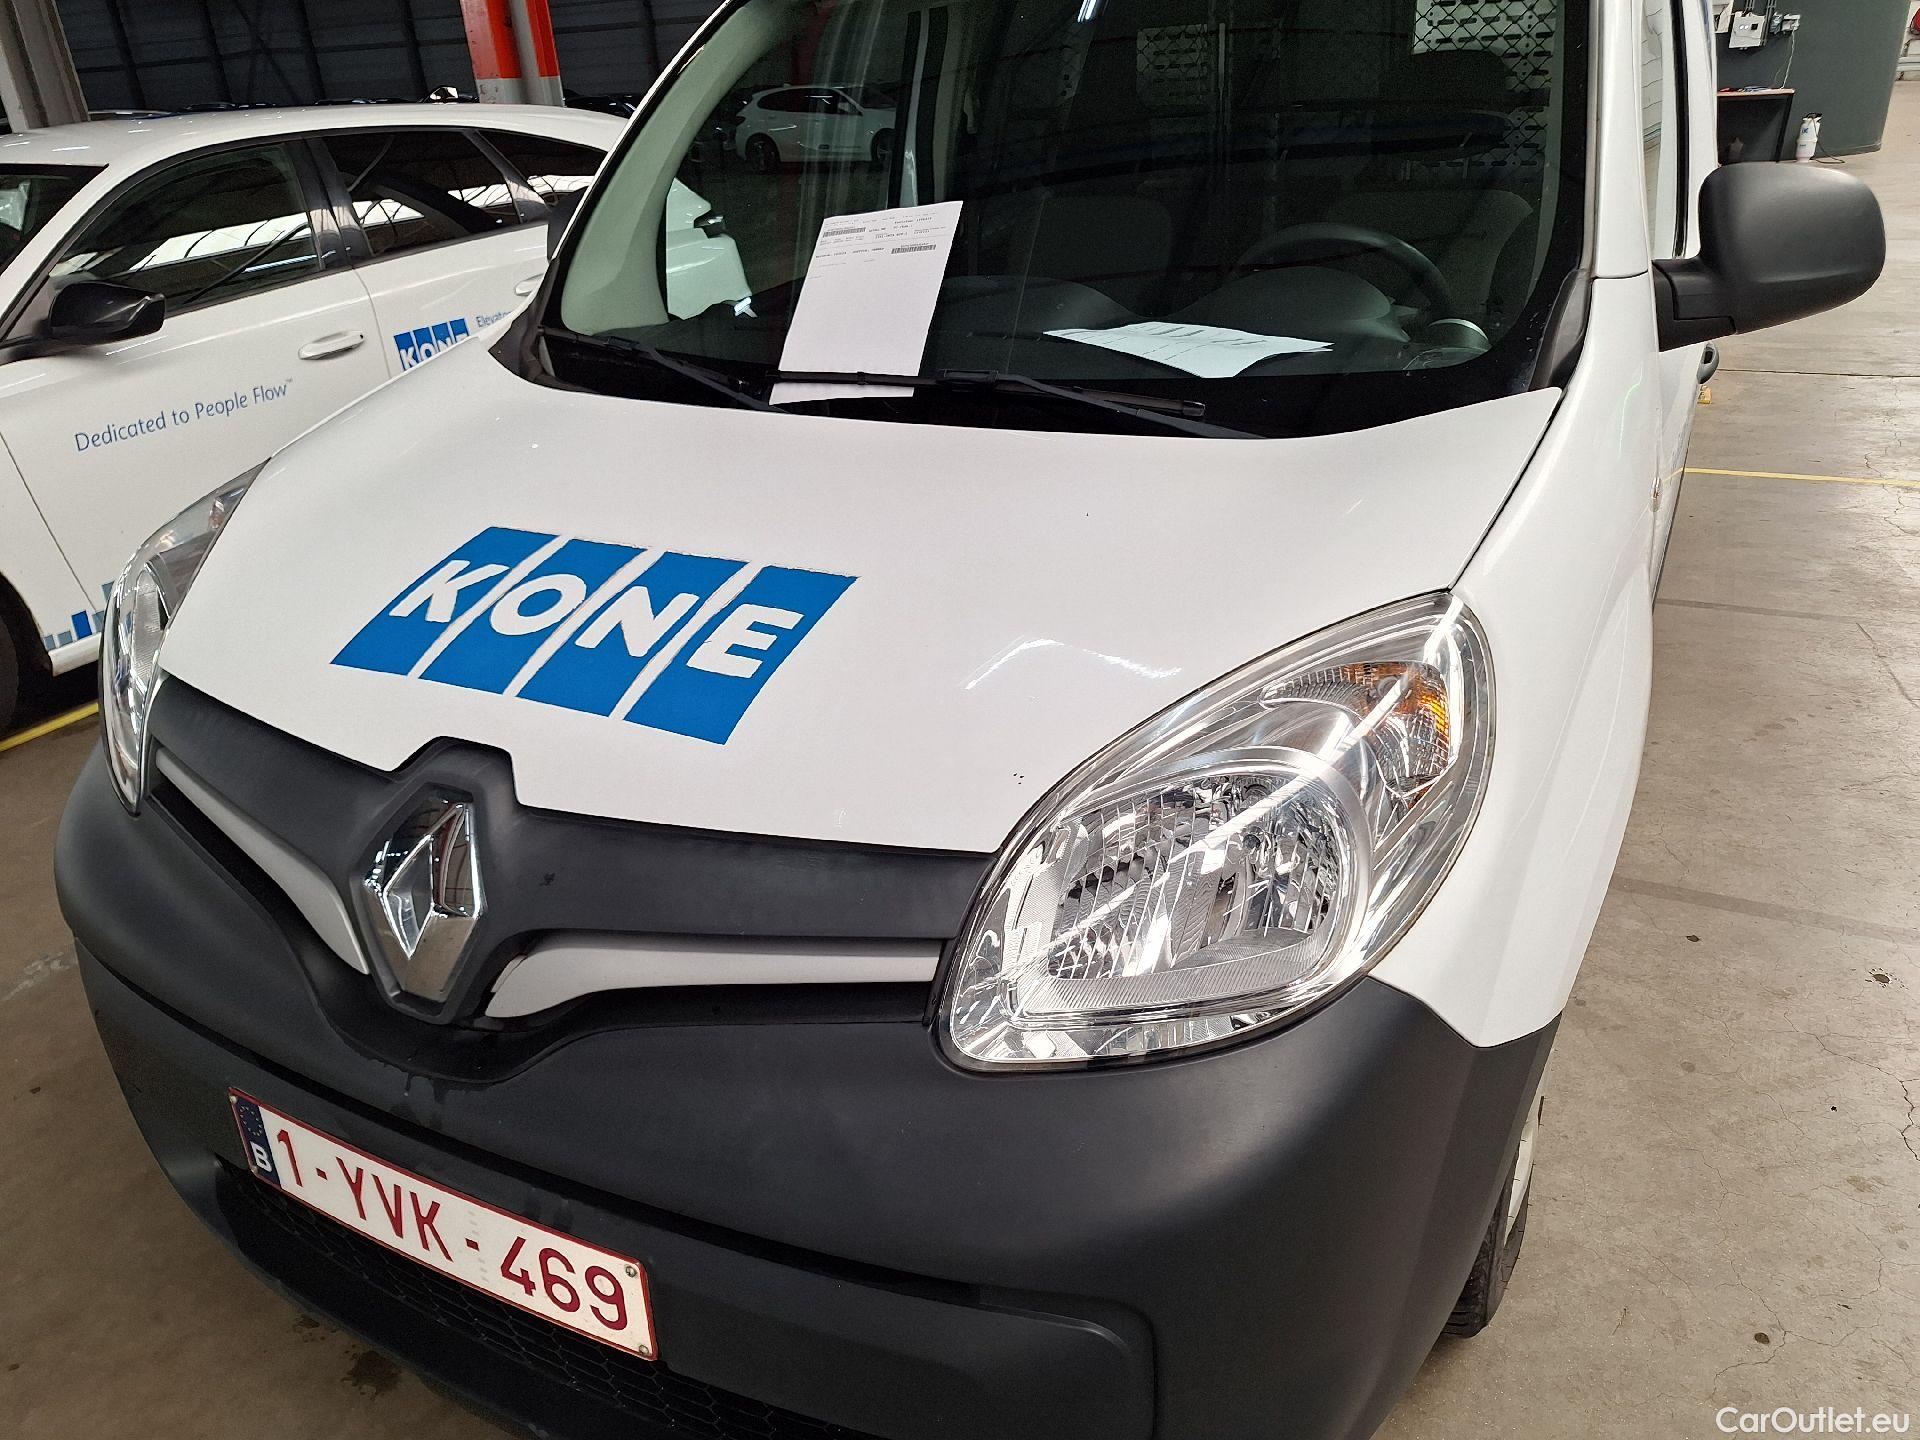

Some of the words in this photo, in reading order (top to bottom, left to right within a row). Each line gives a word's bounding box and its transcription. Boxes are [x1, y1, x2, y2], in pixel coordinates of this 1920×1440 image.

[74, 411, 167, 451] Dedicated
[171, 409, 190, 426] to
[194, 392, 248, 419] People
[389, 560, 804, 679] KONE
[251, 1142, 272, 1173] B
